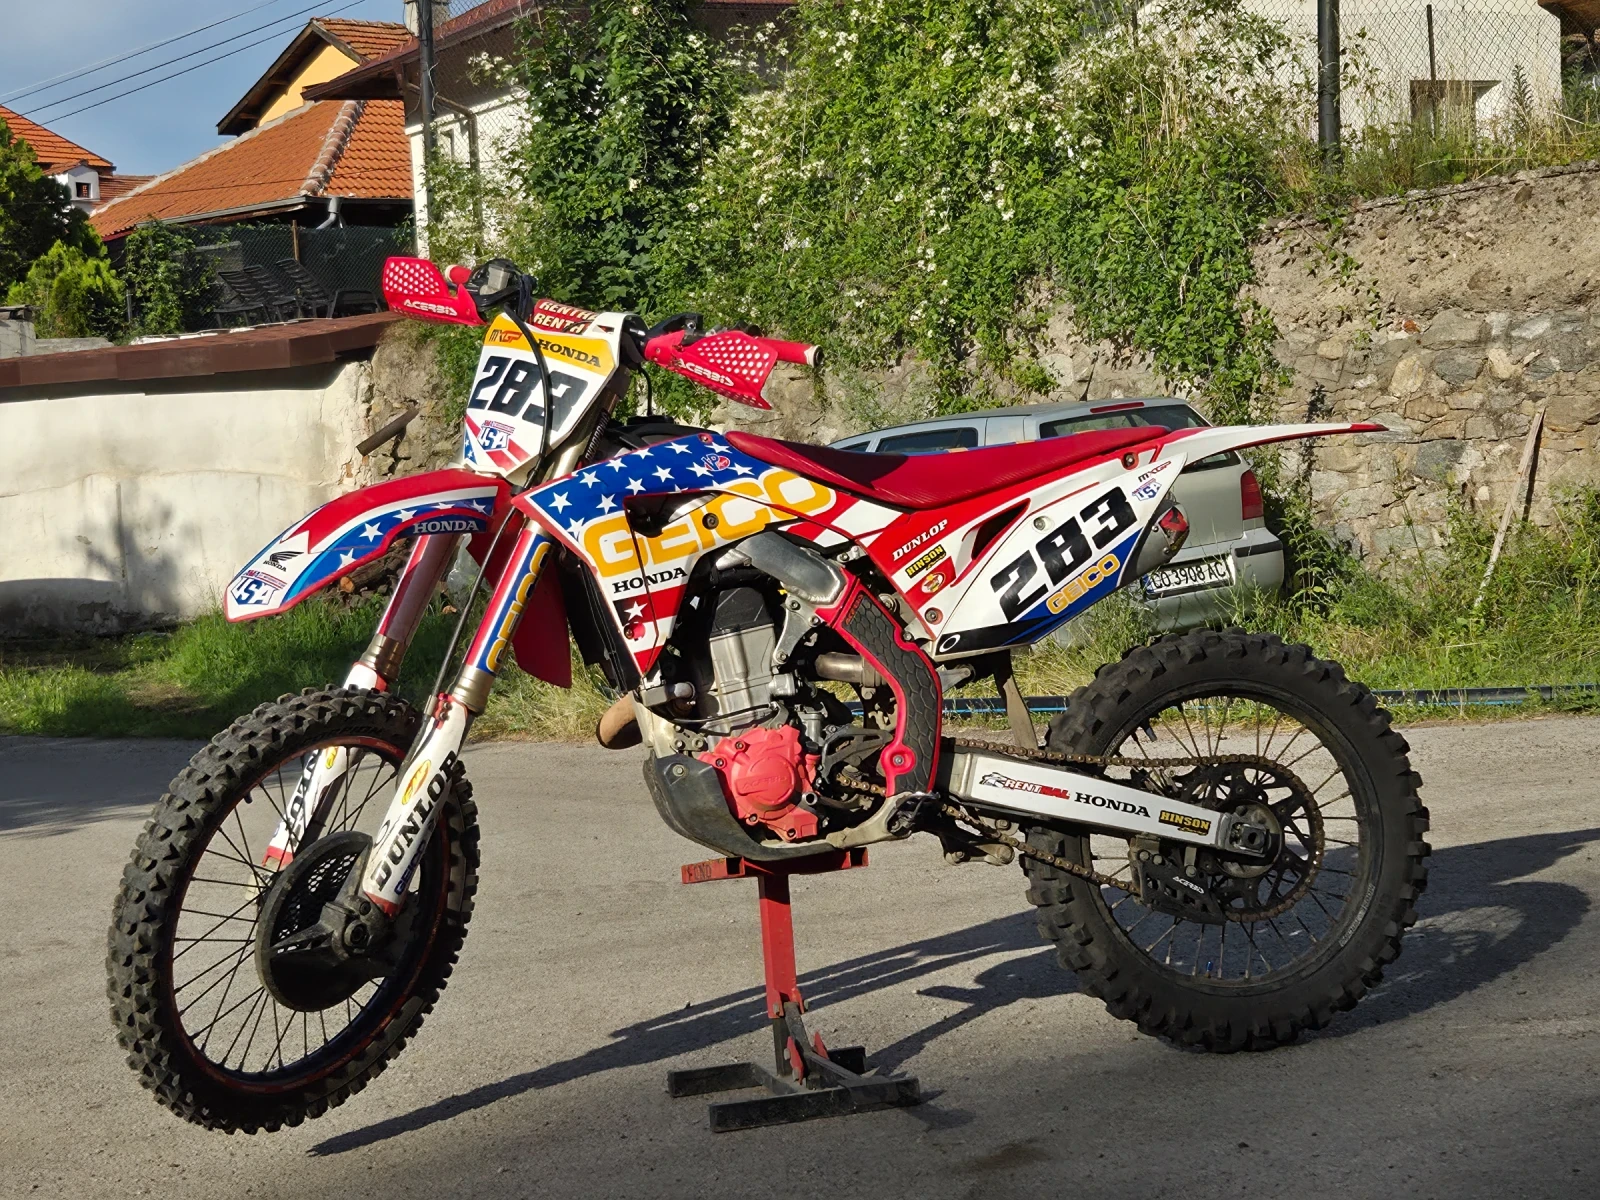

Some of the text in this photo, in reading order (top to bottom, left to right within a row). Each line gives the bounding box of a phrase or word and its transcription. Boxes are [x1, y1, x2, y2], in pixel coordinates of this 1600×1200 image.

[538, 338, 601, 368] HONDA
[467, 355, 589, 432] 283
[411, 519, 479, 534] HONDA
[584, 468, 837, 578] GEICO
[892, 519, 948, 561] DUNLOP
[263, 560, 287, 573] HONDA
[906, 545, 944, 576] HINSON
[990, 486, 1139, 623] 283
[1172, 565, 1206, 585] 3908
[1206, 560, 1226, 580] AC
[612, 566, 688, 594] HONDA
[1046, 553, 1121, 615] GEICO
[370, 749, 458, 893] DUNLOP
[1074, 791, 1152, 818] HONDA
[1159, 811, 1211, 830] HINSON
